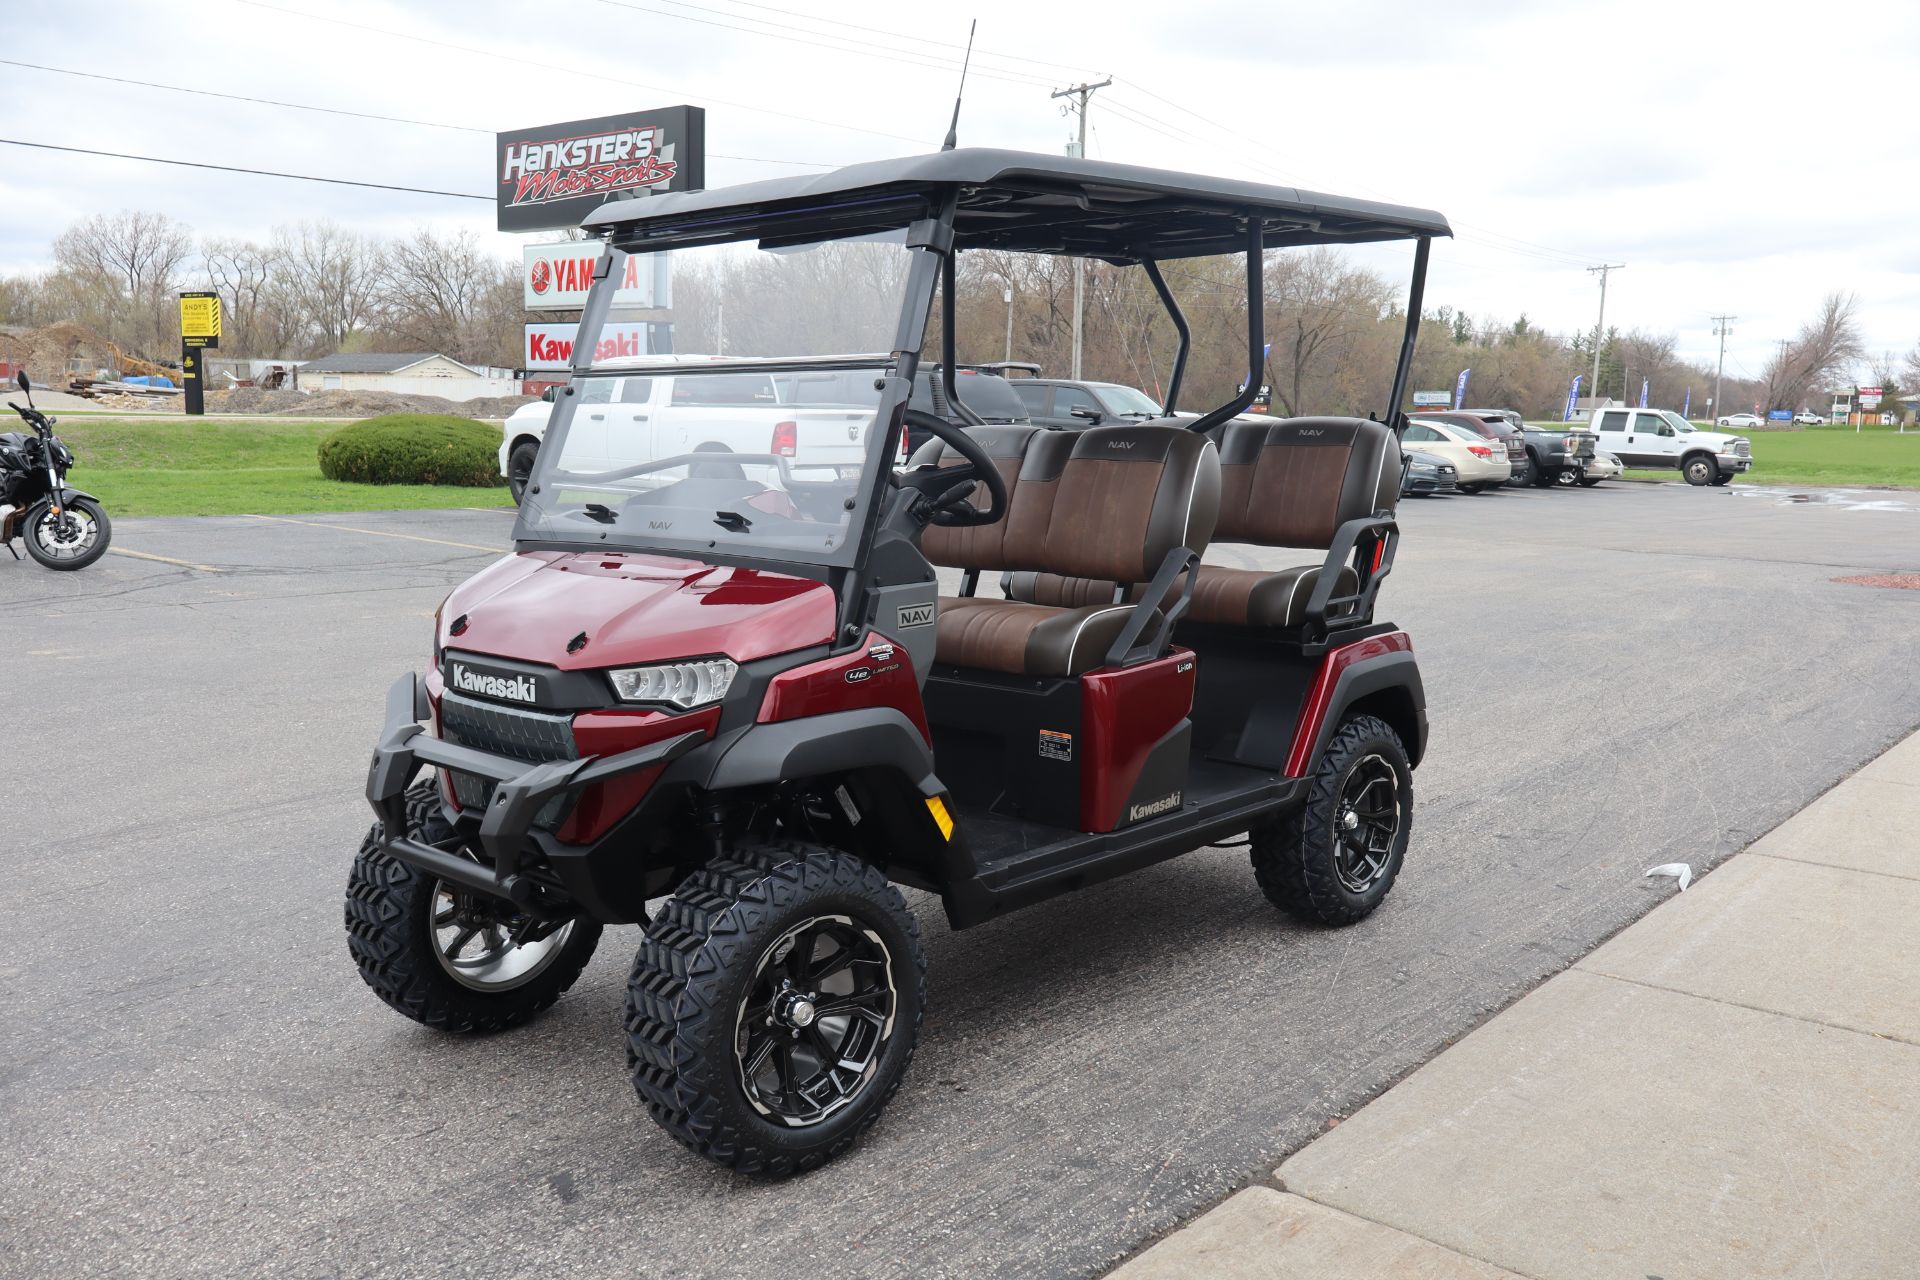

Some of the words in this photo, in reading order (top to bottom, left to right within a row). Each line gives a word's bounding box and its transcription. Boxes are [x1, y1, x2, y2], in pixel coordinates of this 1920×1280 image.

[554, 255, 639, 291] YAMA
[530, 332, 639, 361] Kawsaki
[1107, 440, 1136, 449] NAV
[648, 520, 673, 529] NAV
[901, 609, 931, 625] NAV
[453, 663, 536, 702] Kawasaki
[1129, 791, 1181, 821] Kawasaki
